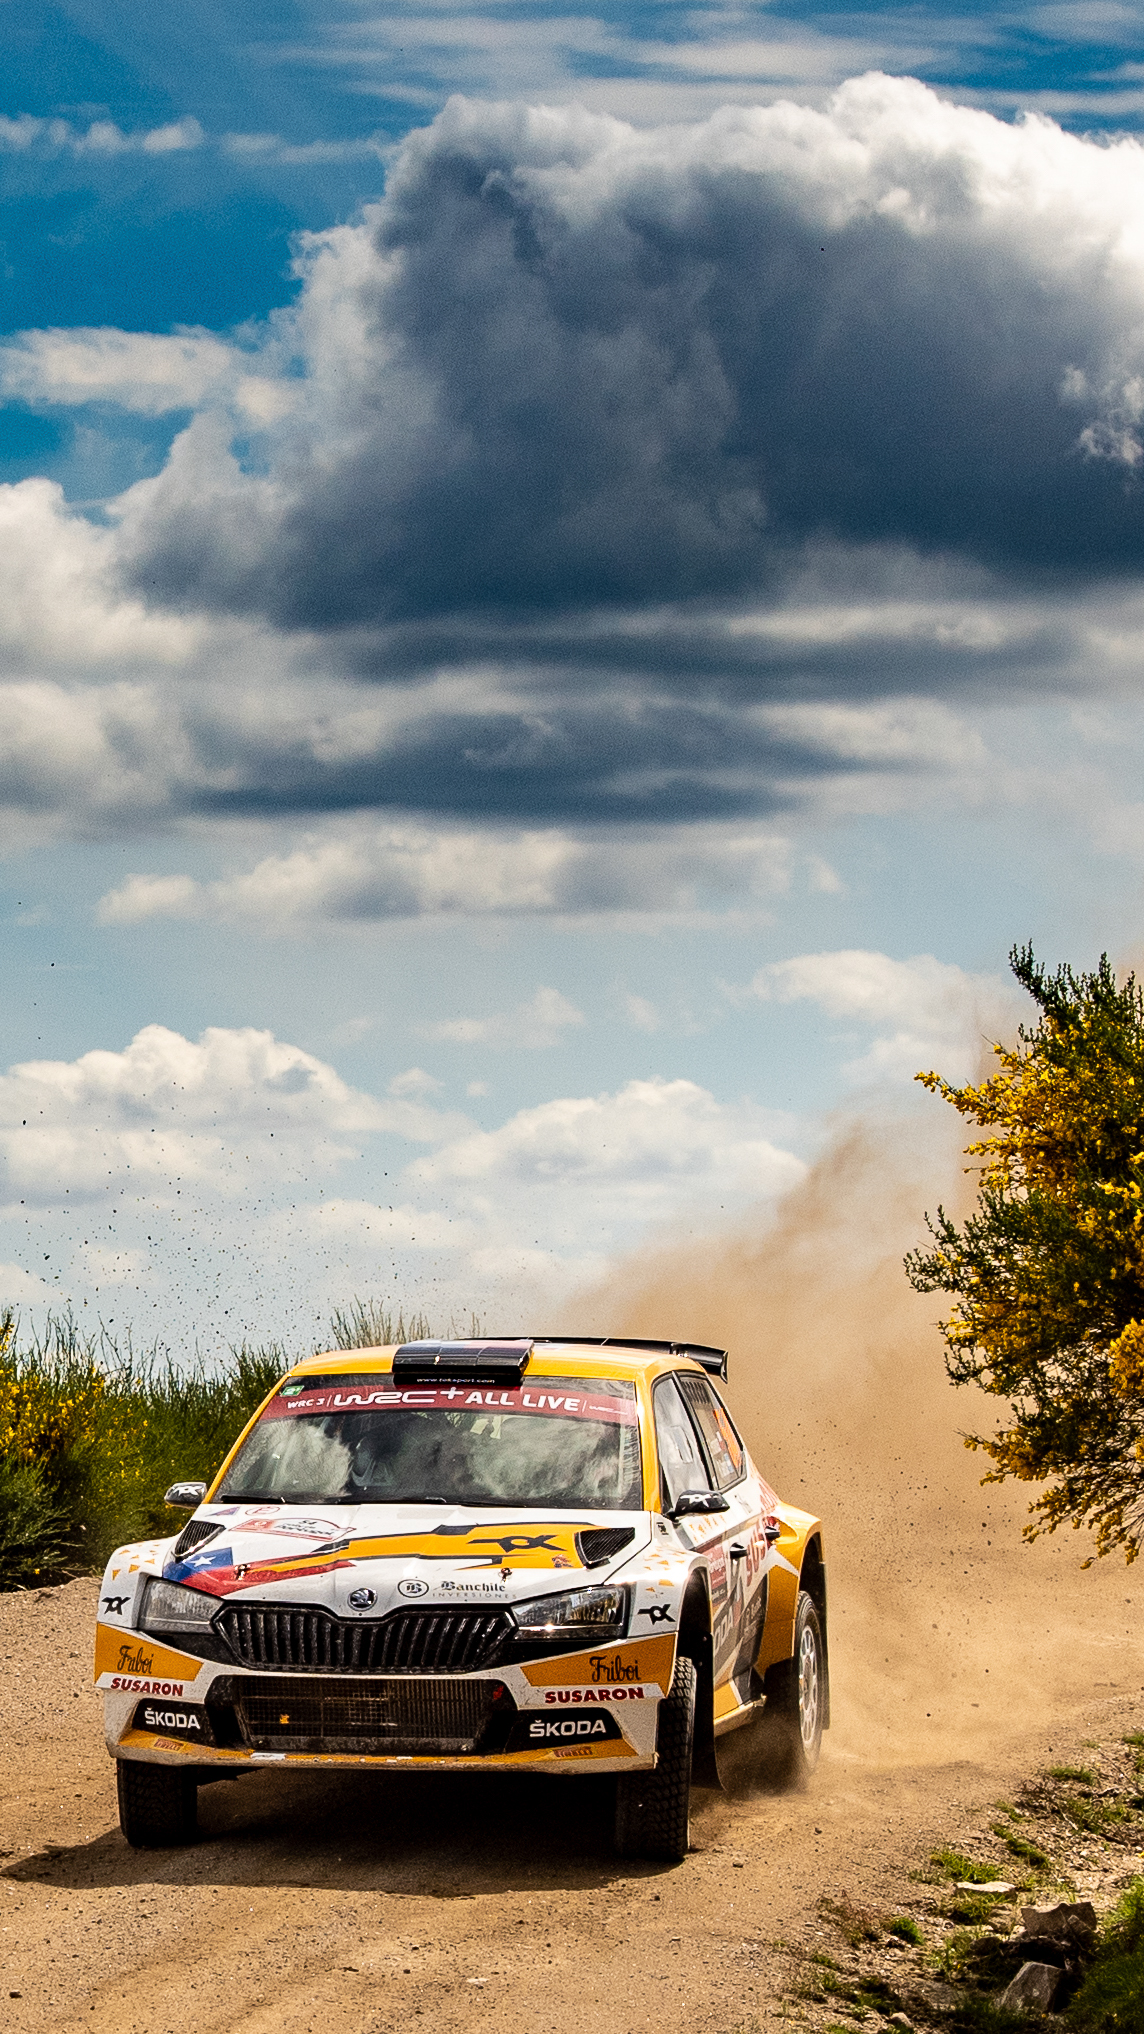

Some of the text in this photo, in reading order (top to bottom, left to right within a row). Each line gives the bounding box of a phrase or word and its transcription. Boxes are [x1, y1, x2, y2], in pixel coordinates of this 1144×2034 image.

[287, 1399, 313, 1409] WRC
[316, 1398, 325, 1407] 3
[465, 1391, 514, 1406] ALL
[522, 1394, 580, 1412] LIVE
[440, 1580, 506, 1592] Banchile
[589, 1655, 641, 1682] Friboi
[110, 1677, 184, 1697] SUSARON
[544, 1686, 645, 1704] SUSARON
[144, 1707, 201, 1730] ŠKODA
[529, 1719, 607, 1738] ŠKODA
